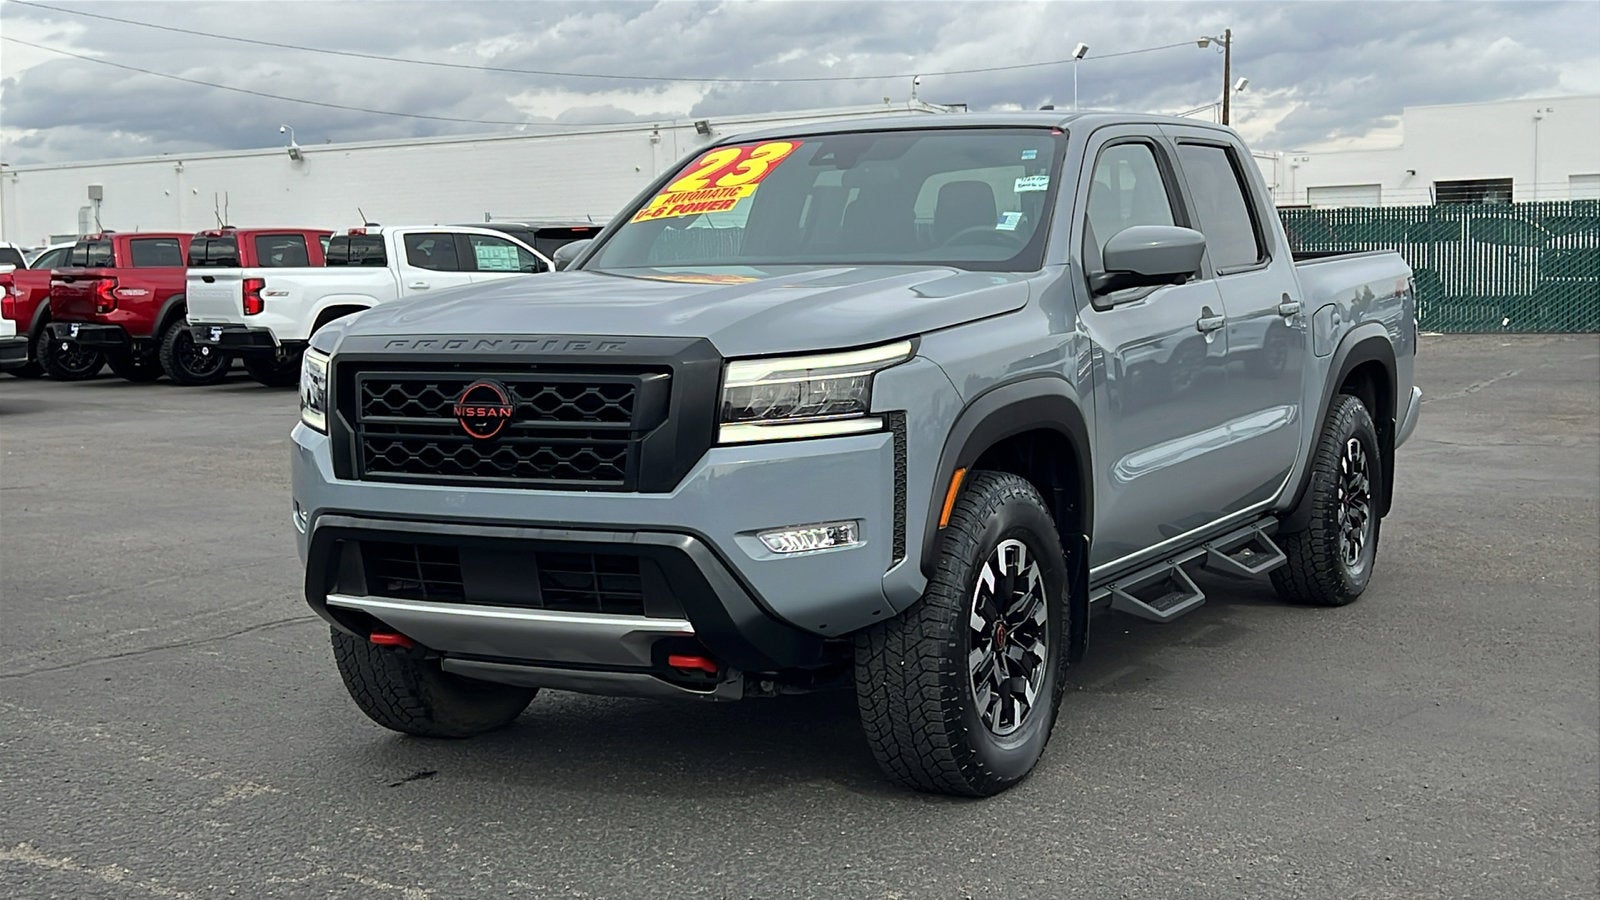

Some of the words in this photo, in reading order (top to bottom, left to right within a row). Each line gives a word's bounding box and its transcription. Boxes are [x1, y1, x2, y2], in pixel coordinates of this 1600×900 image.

[666, 141, 794, 192] 23
[663, 186, 743, 205] AUTOMATIC
[634, 206, 668, 221] V-6
[667, 199, 737, 216] POWER
[384, 339, 627, 351] FRONTIER
[453, 407, 512, 417] NISSAN
